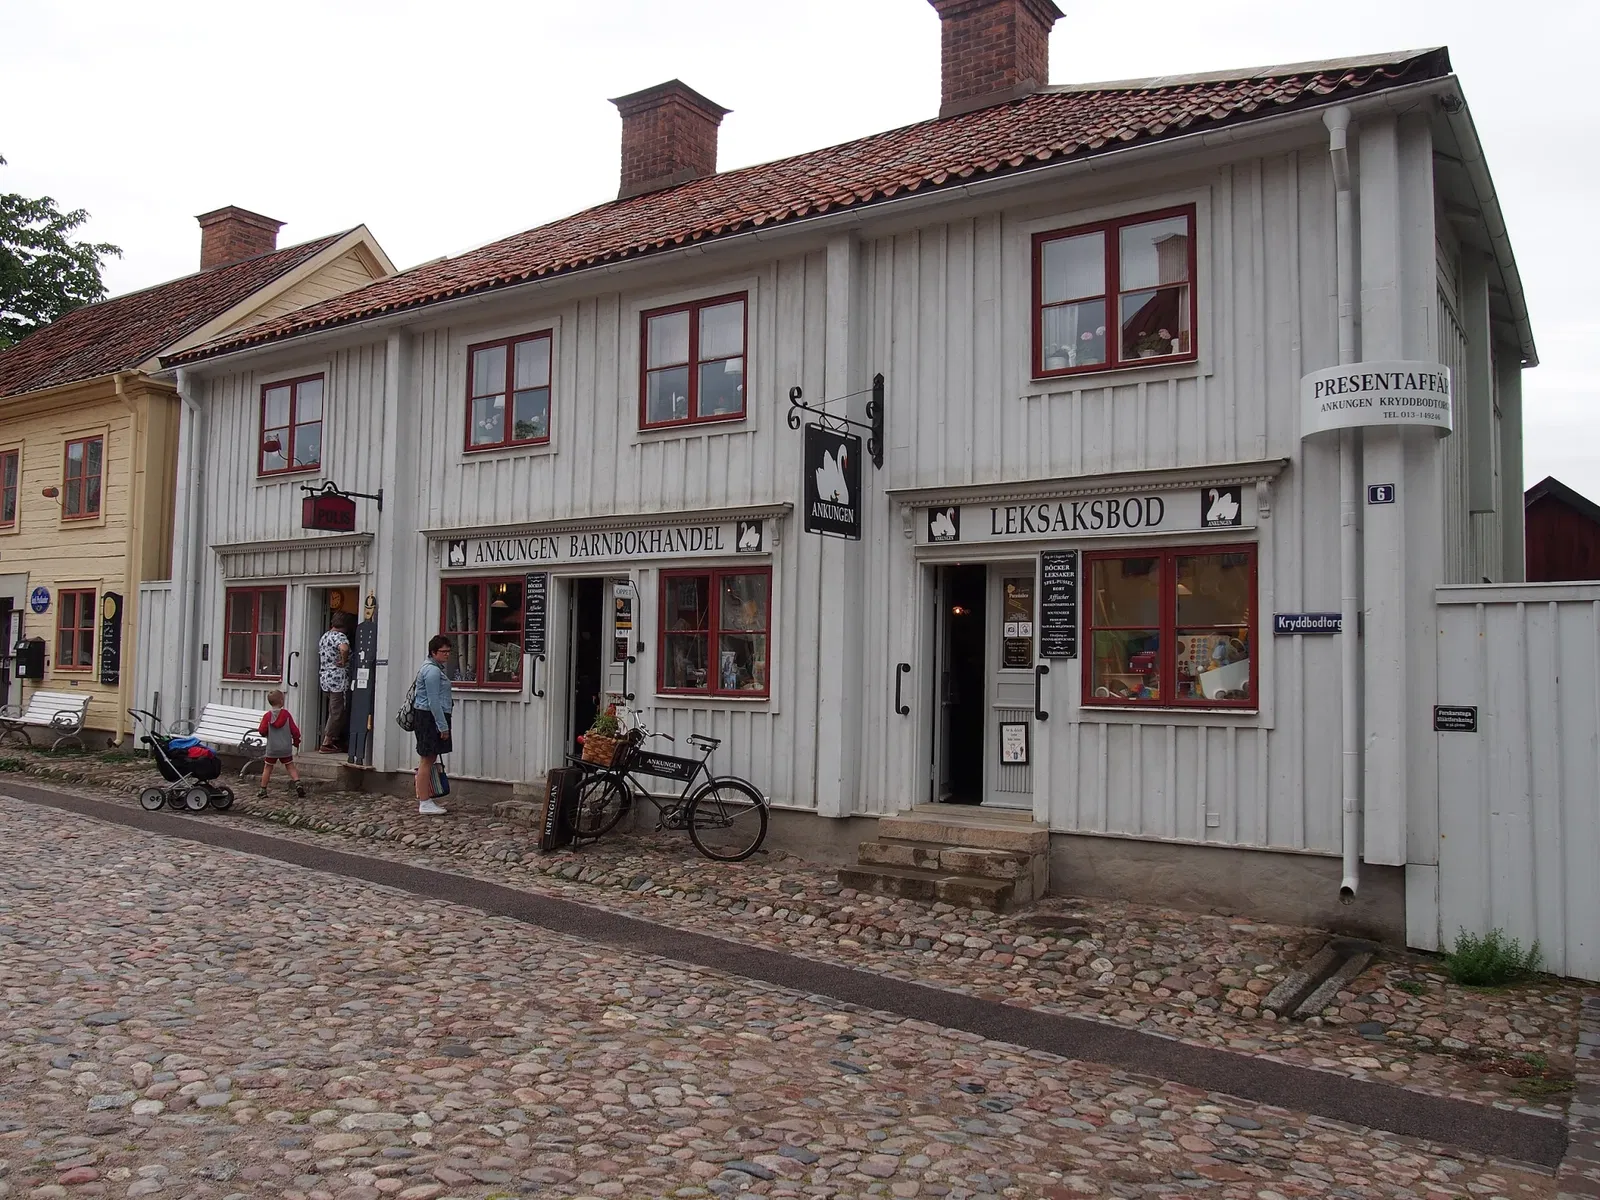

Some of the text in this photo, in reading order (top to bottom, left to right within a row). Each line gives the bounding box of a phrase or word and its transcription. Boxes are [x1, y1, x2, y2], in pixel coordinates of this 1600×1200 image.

[1321, 398, 1373, 412] ANKUNGEN
[1383, 411, 1399, 419] TEL.
[1376, 487, 1386, 501] 6
[318, 509, 350, 525] POLIS
[811, 502, 854, 523] ANKUNGEN
[990, 496, 1165, 536] LEKSAKSBOD
[474, 526, 725, 562] ANKUNGEN BARNBOKHANDEL
[646, 758, 682, 770] ANKUNGEN
[545, 785, 558, 835] KRINGLAN
